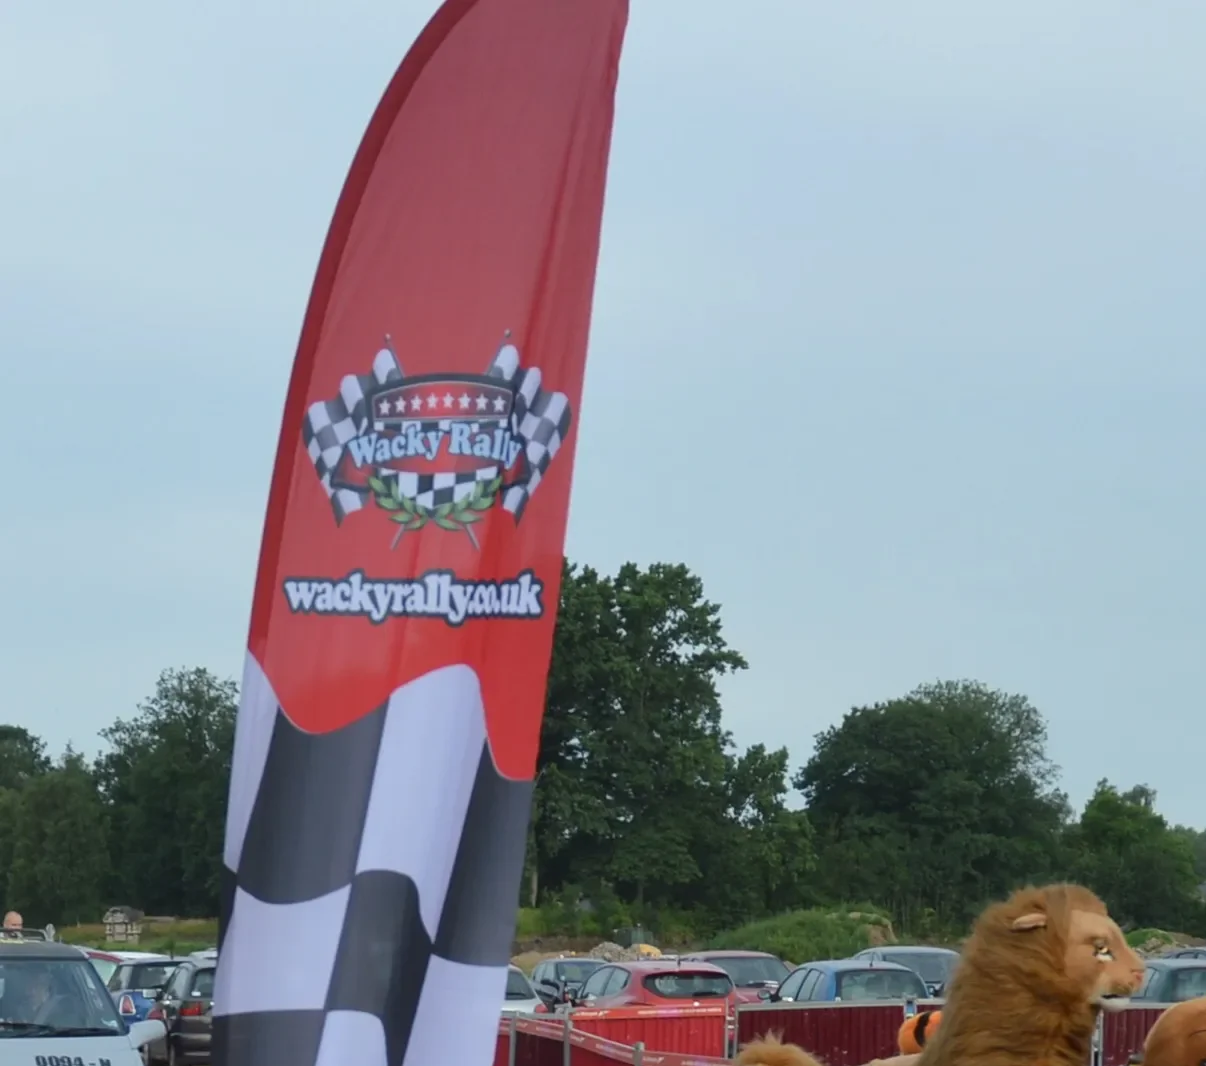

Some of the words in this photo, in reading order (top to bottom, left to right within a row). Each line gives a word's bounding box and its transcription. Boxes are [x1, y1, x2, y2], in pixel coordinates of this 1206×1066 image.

[347, 422, 445, 467] Wacky
[448, 422, 522, 470] Rally
[283, 571, 542, 624] wackyrally.co.uk
